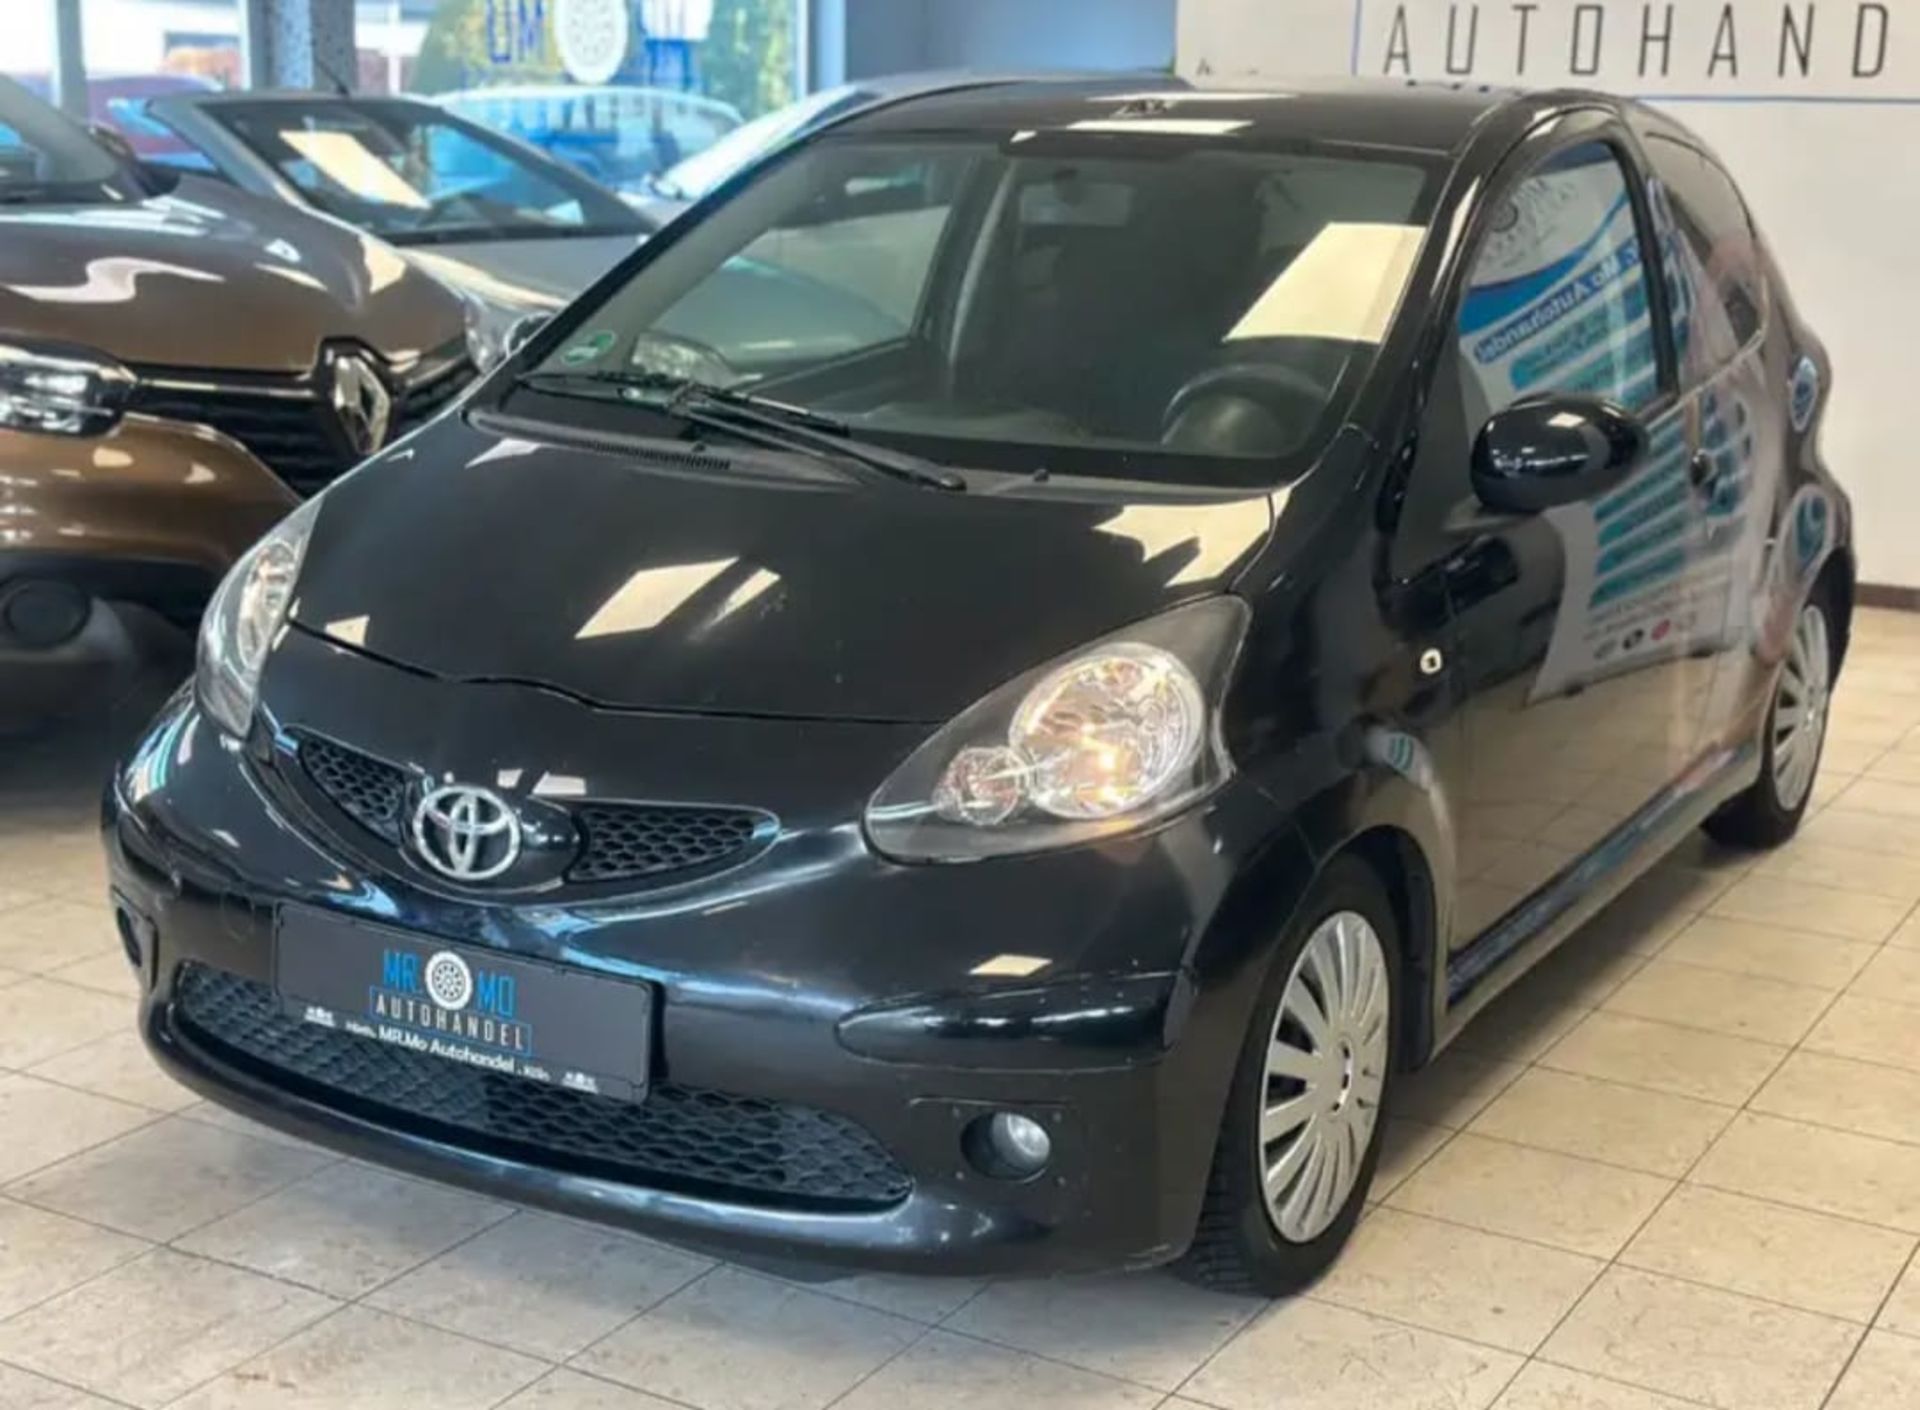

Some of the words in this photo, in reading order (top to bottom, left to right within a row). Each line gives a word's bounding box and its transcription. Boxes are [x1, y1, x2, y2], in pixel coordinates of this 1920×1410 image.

[1382, 3, 1889, 78] AUTOHAND
[477, 970, 514, 1019] MO
[375, 994, 524, 1050] AUTOHANDEL
[429, 1040, 515, 1073] Autohandel
